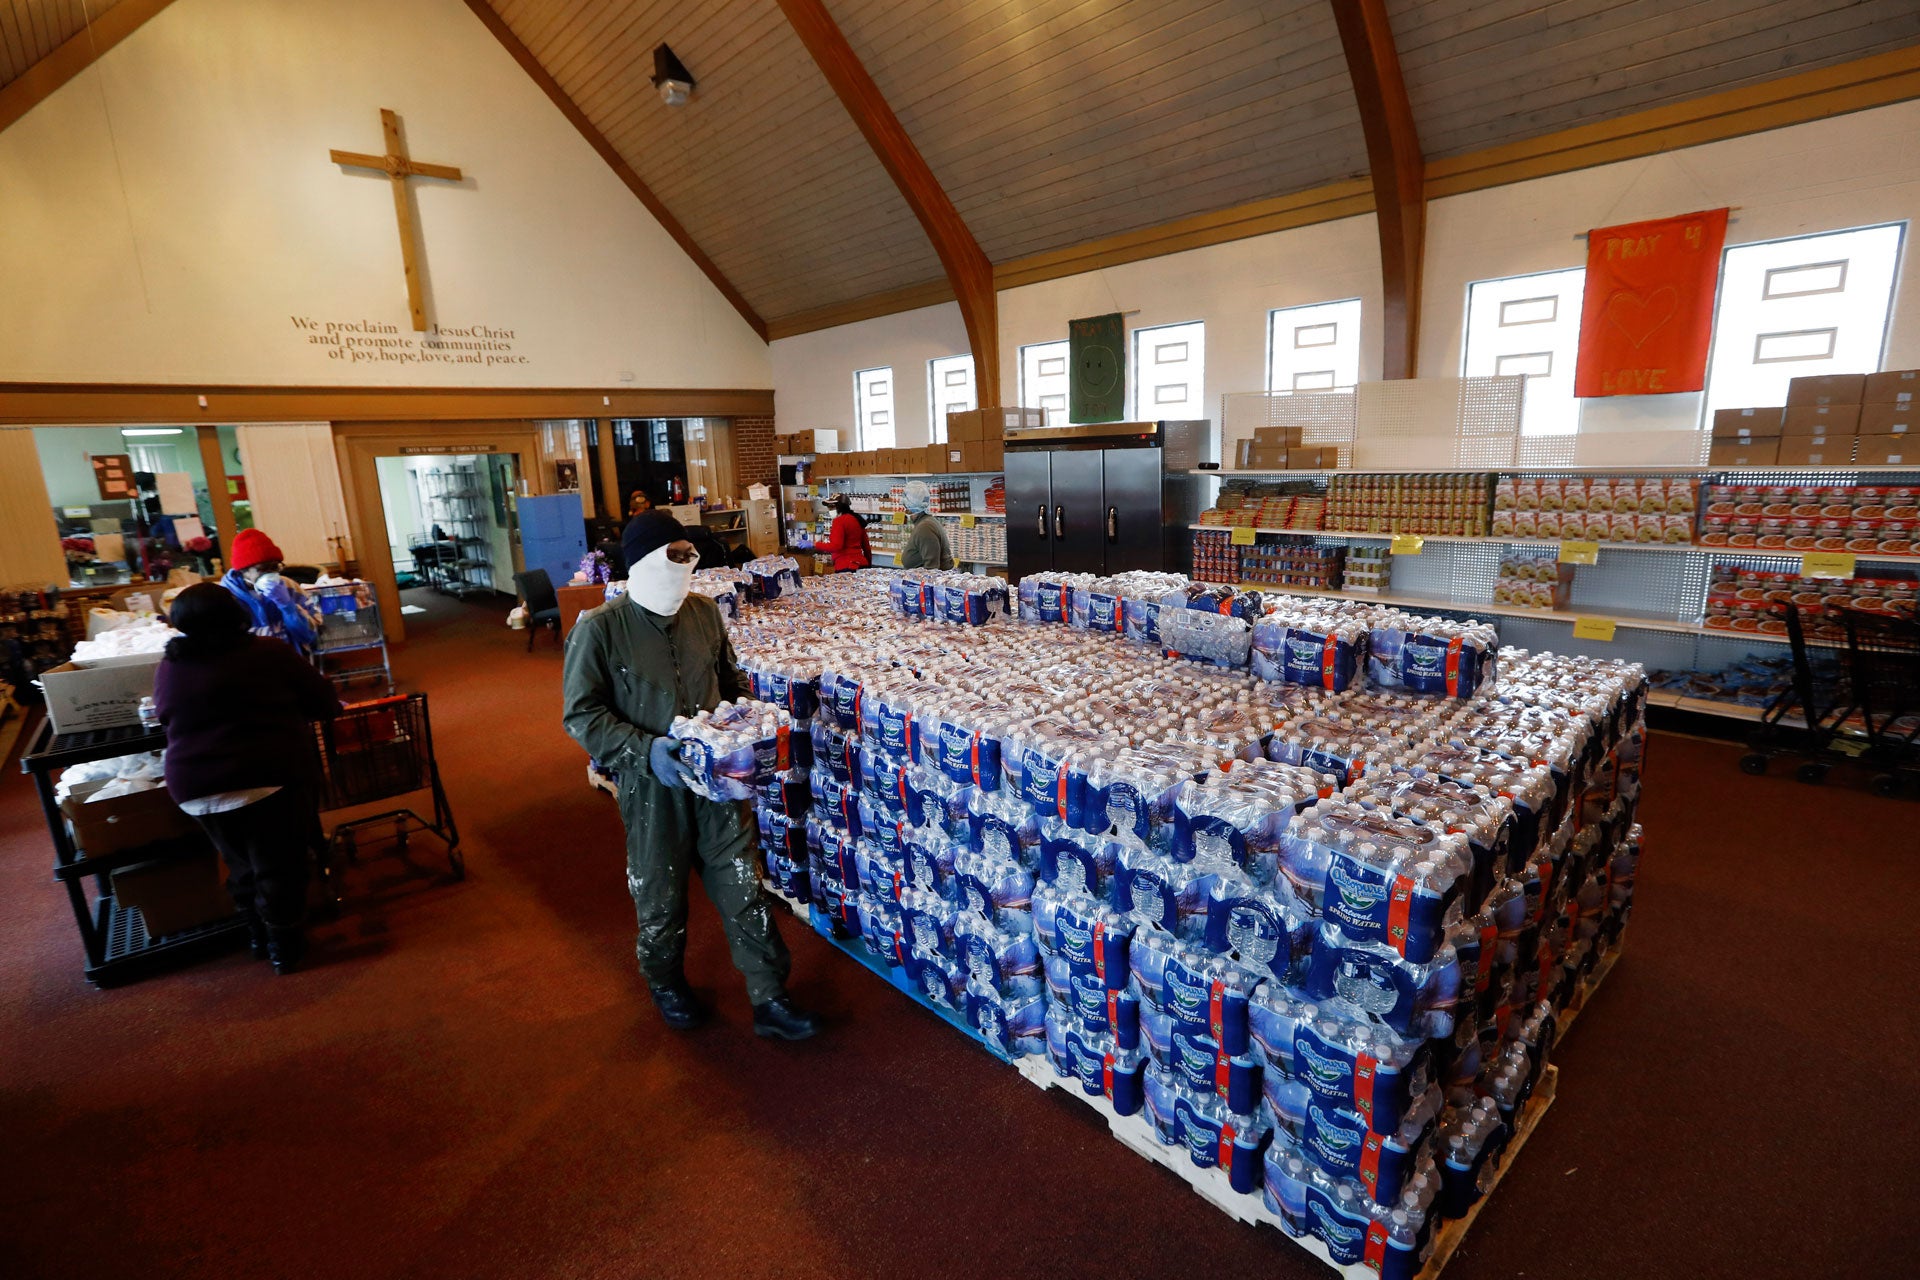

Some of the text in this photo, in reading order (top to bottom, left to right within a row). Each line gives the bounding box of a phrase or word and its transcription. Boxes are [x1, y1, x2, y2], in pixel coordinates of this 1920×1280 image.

[1607, 225, 1702, 260] PRAY 4
[290, 315, 319, 331] We
[325, 319, 399, 335] proclaim
[308, 332, 513, 352] and promote communities
[327, 344, 346, 360] of
[485, 352, 532, 367] peace.
[1602, 368, 1667, 390] LOVE
[1328, 905, 1382, 930] SPRING WATER
[1337, 901, 1373, 921] Natural
[1172, 1000, 1199, 1017] Natural
[1183, 1014, 1207, 1024] WATER
[1306, 1069, 1340, 1091] Natural
[1321, 1086, 1349, 1099] WATER
[1315, 1136, 1348, 1160] Natural
[1327, 1154, 1355, 1169] WATER
